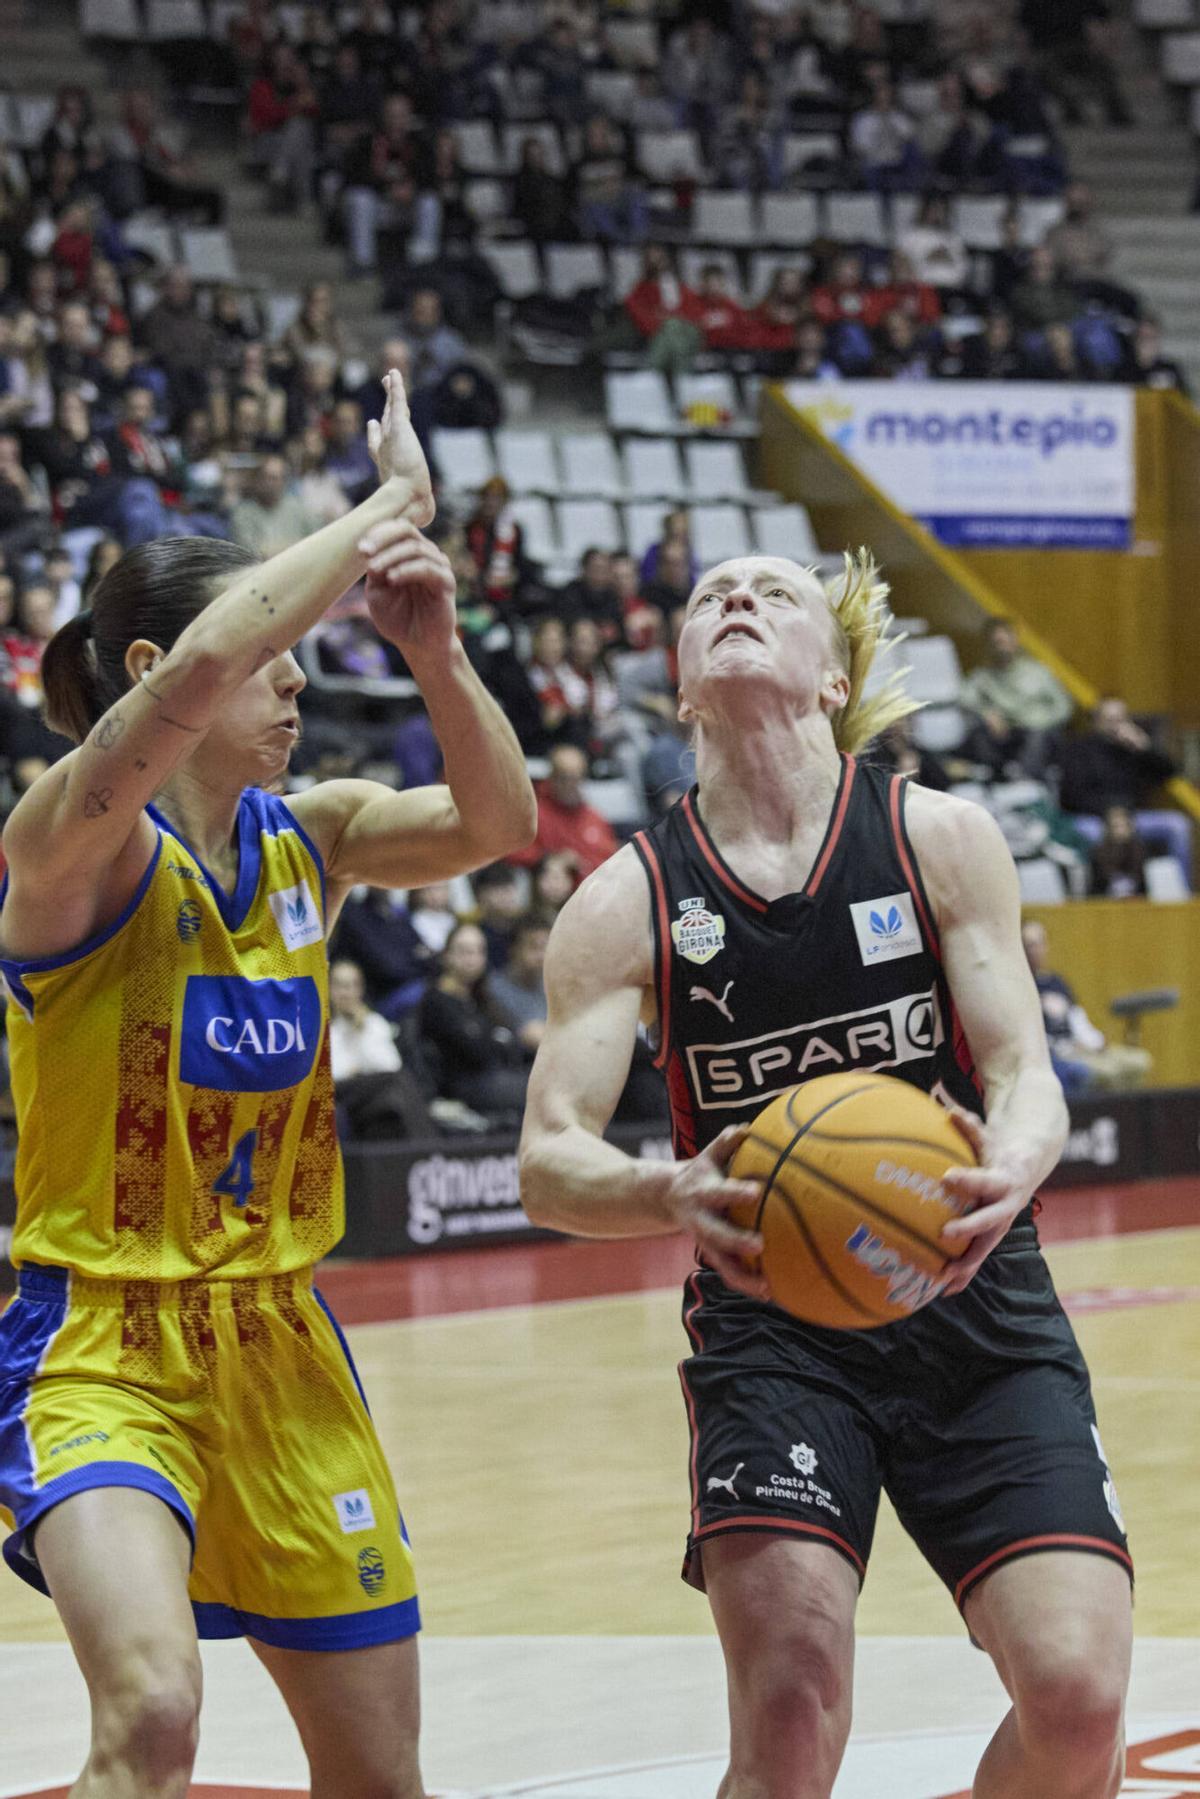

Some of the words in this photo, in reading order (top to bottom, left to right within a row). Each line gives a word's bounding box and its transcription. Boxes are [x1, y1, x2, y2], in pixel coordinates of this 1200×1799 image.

[866, 402, 1118, 457] montepio
[678, 935, 721, 953] GIRONA
[707, 1021, 892, 1093] SPAR
[212, 1128, 261, 1208] 4
[755, 1486, 798, 1500] Pirineu
[799, 1491, 813, 1504] de
[770, 1474, 805, 1489] Costa
